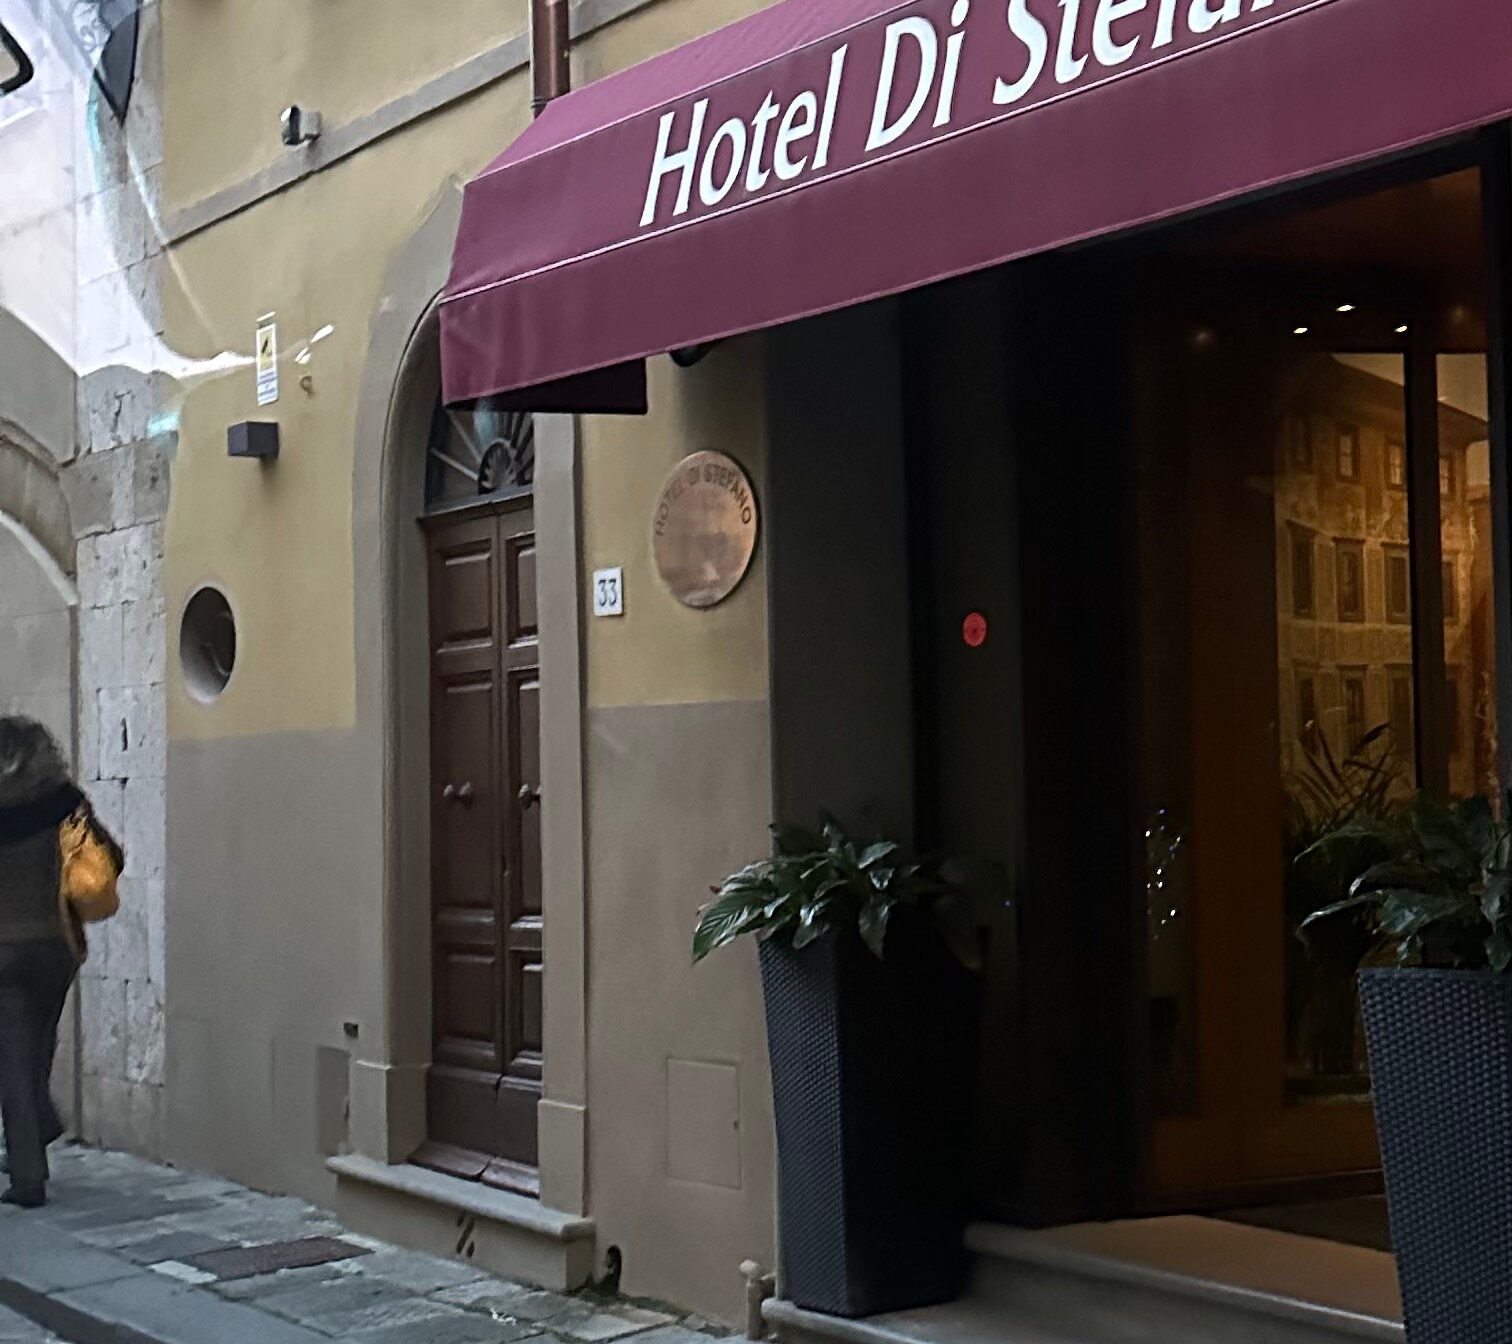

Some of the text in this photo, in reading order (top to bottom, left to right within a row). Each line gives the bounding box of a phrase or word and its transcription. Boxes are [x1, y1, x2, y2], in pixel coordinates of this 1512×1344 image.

[638, 43, 848, 228] Hotel
[655, 475, 684, 536] HOTEL
[703, 462, 752, 525] STEFANO
[598, 577, 618, 607] 33
